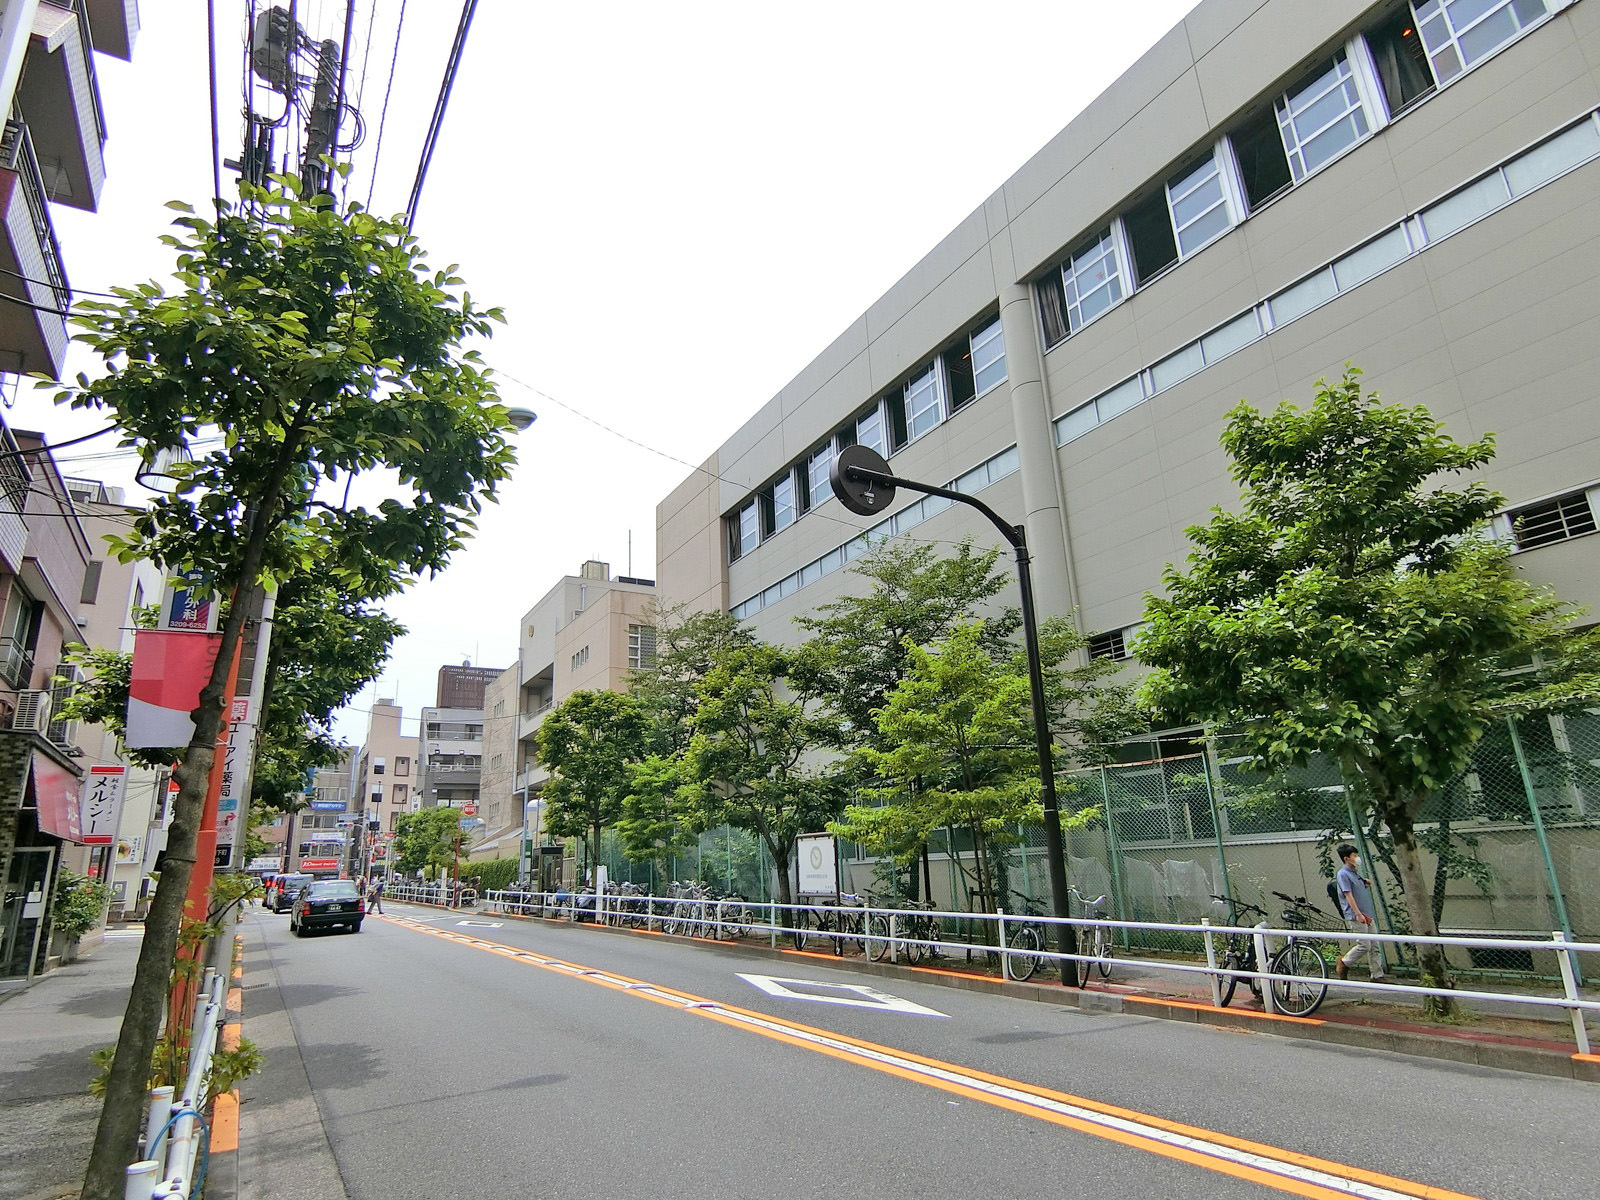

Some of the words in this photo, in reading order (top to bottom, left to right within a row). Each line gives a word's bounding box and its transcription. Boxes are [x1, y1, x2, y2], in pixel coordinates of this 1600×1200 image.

[169, 620, 207, 629] 3209-6252
[221, 722, 239, 797] ユーアイ薬局
[89, 776, 109, 834] メルシー
